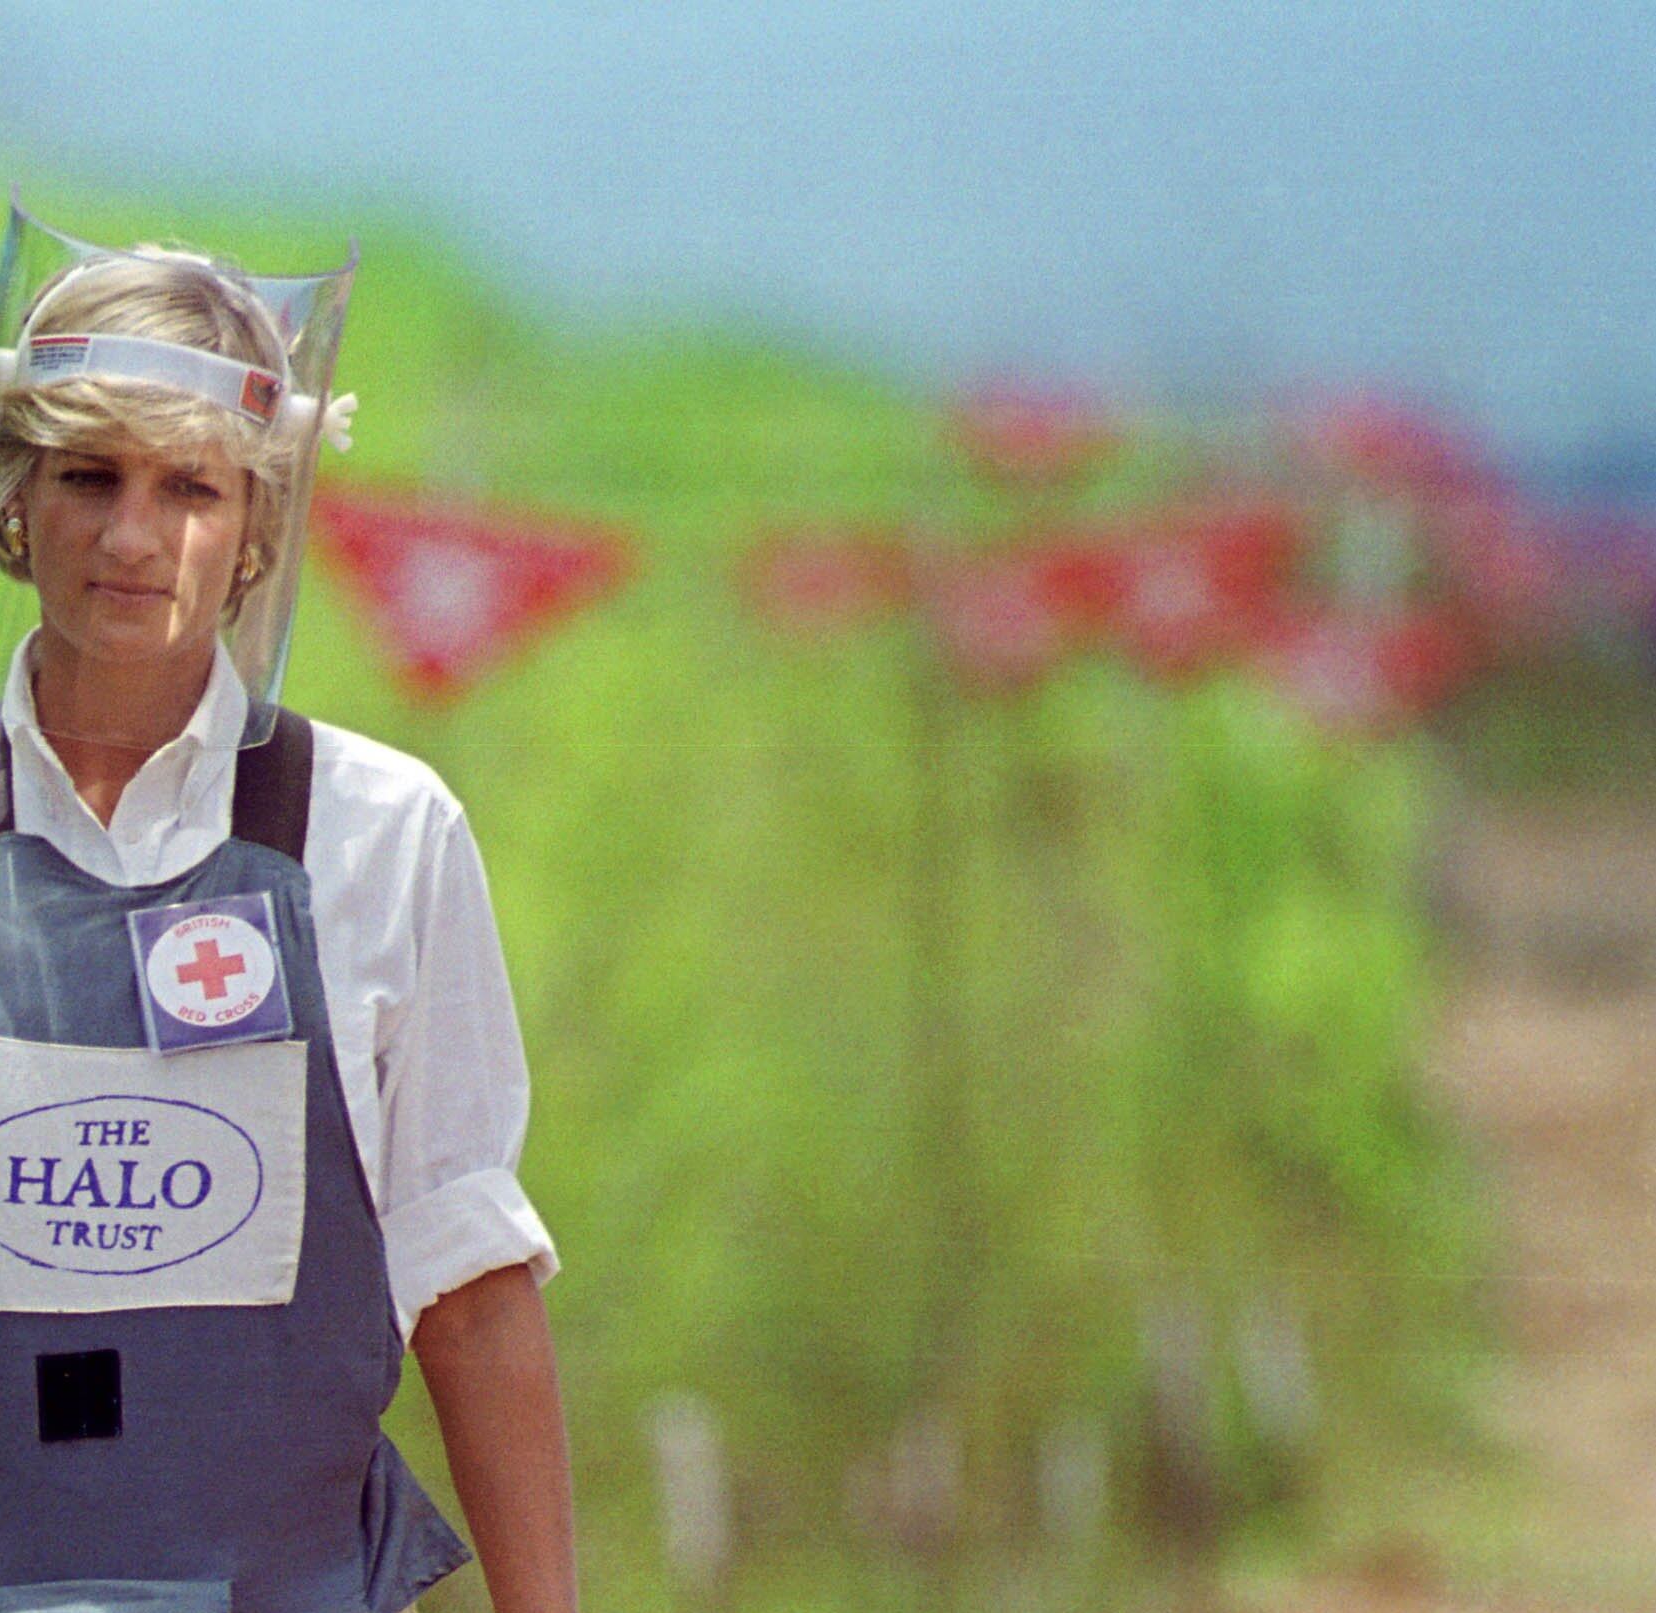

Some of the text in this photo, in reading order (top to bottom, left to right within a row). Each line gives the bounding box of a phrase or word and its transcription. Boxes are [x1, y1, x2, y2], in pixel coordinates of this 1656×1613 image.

[175, 917, 231, 938] BRITISH
[178, 993, 260, 1022] RED CROSS
[74, 1120, 150, 1146] THE
[3, 1156, 213, 1210] HALO
[45, 1220, 163, 1251] TRUST
